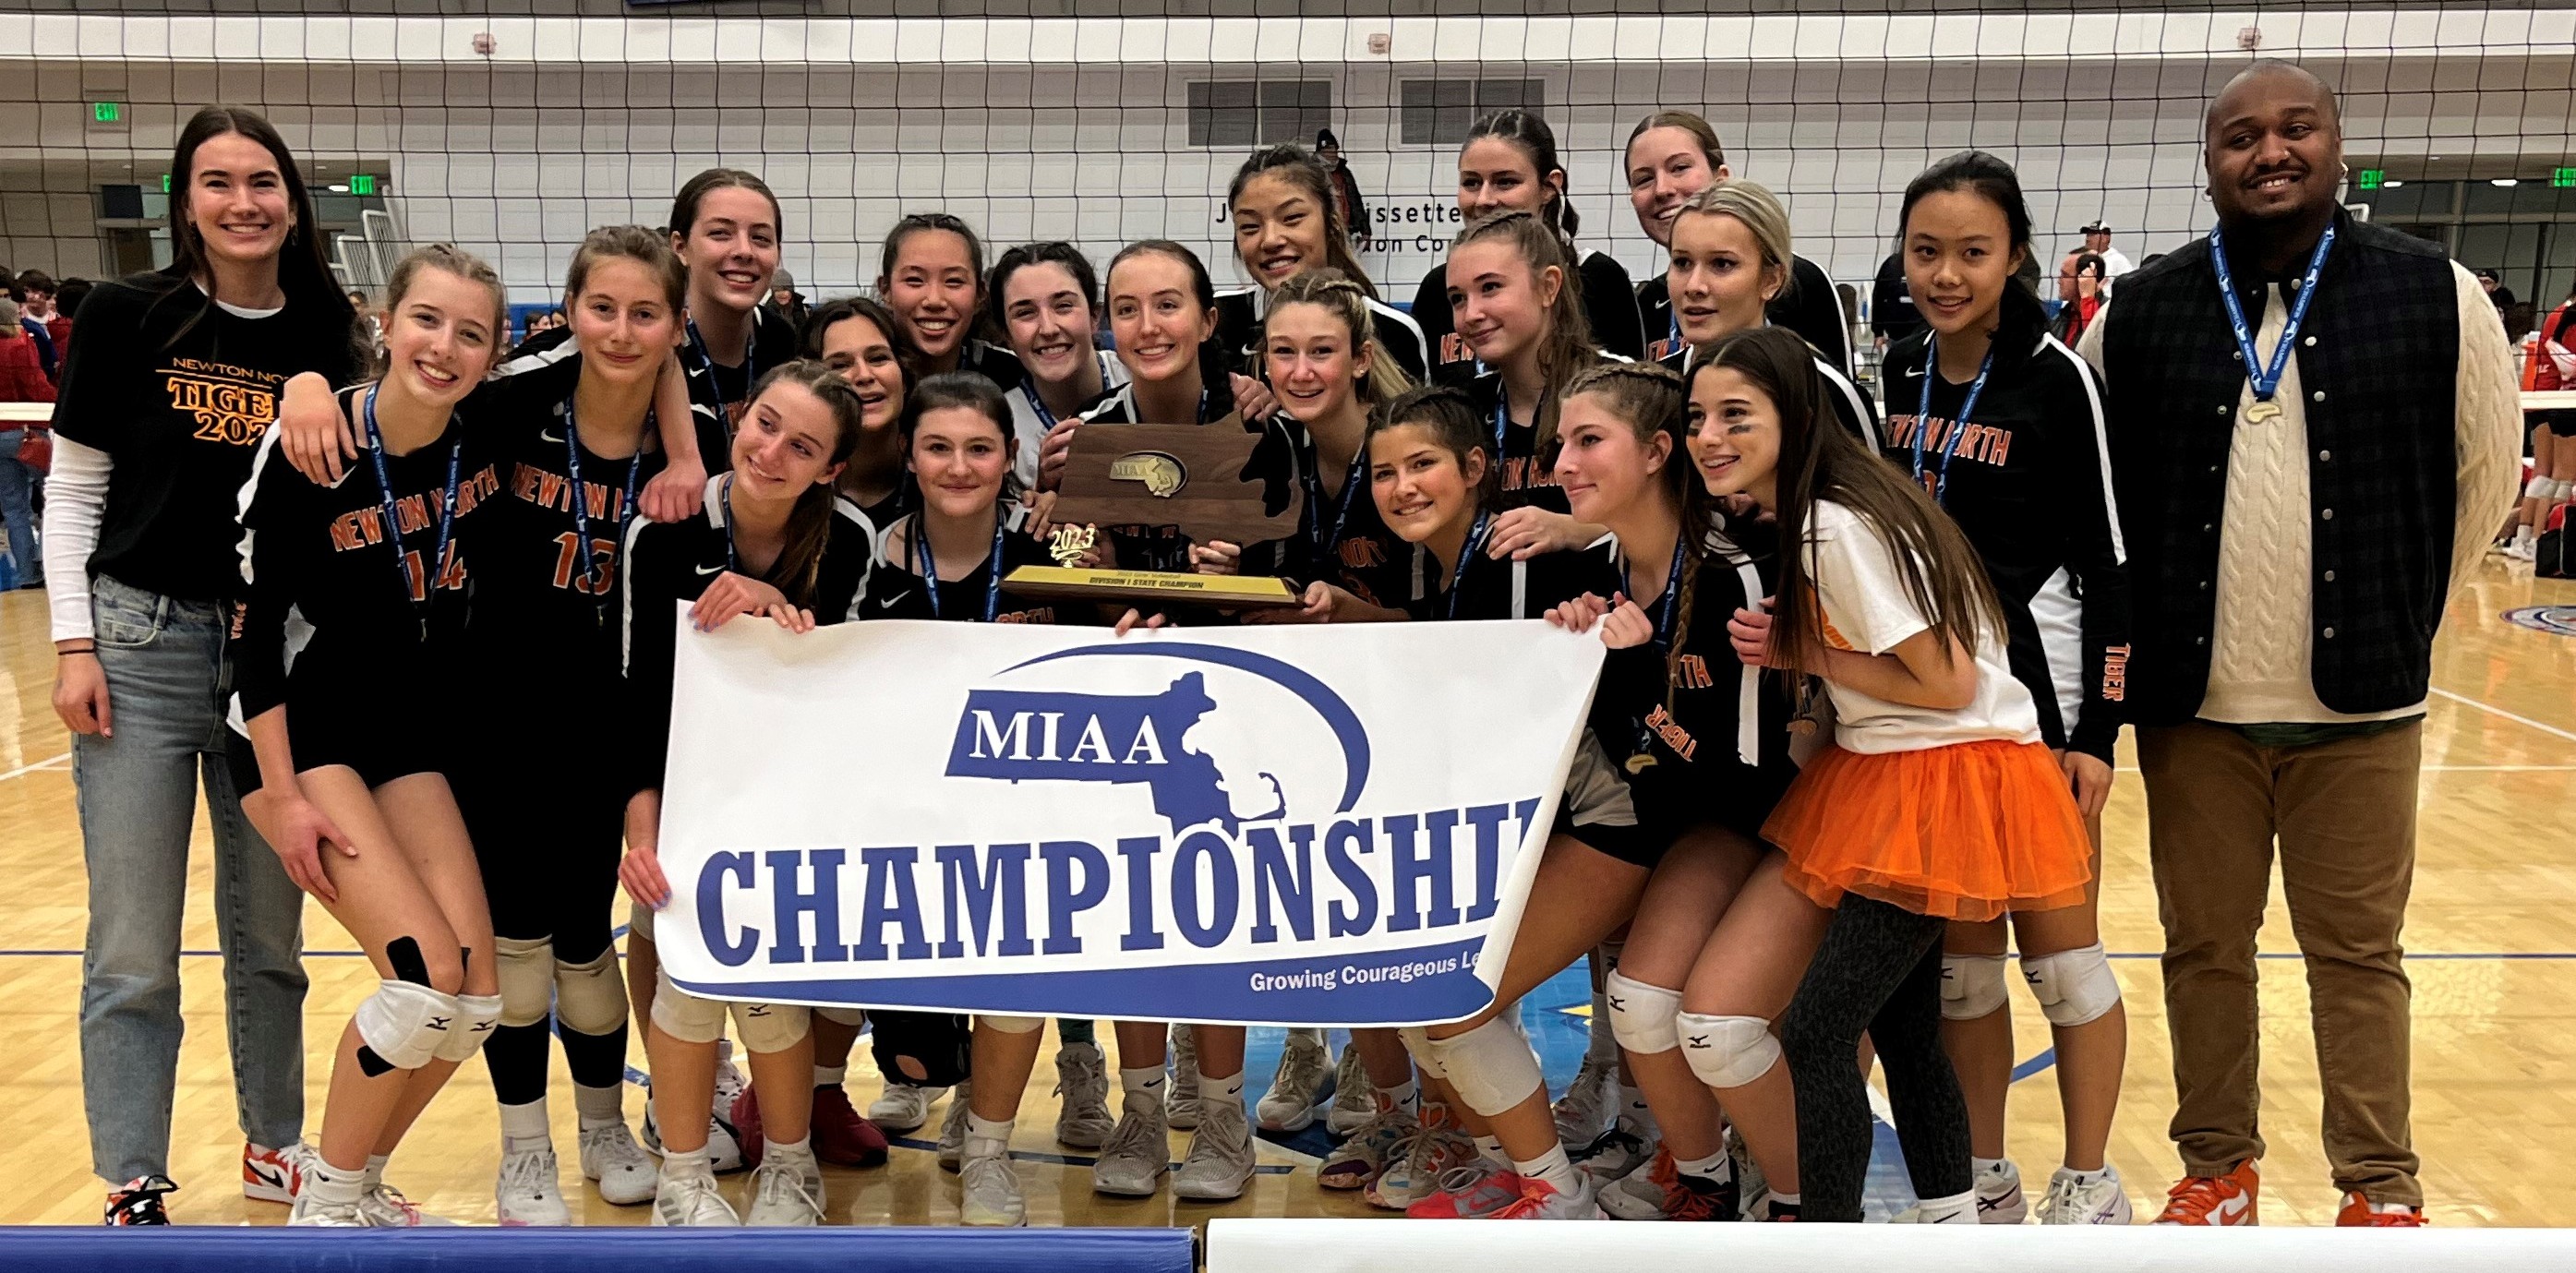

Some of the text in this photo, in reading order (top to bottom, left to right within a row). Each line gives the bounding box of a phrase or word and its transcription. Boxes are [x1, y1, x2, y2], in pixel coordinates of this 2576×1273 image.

[1415, 234, 1443, 252] Co
[173, 356, 254, 378] NEWTON
[166, 376, 275, 424] TIGE
[510, 461, 608, 521] NEWTN
[552, 531, 617, 595] 13
[1049, 527, 1095, 551] 2023
[399, 537, 468, 602] 14
[1089, 576, 1126, 585] DIVISION
[1132, 579, 1158, 587] STATE
[1159, 581, 1204, 589] CHAMPION
[2102, 642, 2131, 702] TIGER
[969, 709, 1169, 764] MIAA
[696, 796, 1543, 967] CHAMPIONSHI
[1250, 969, 1337, 991] Growing
[1342, 957, 1458, 985] Courageous
